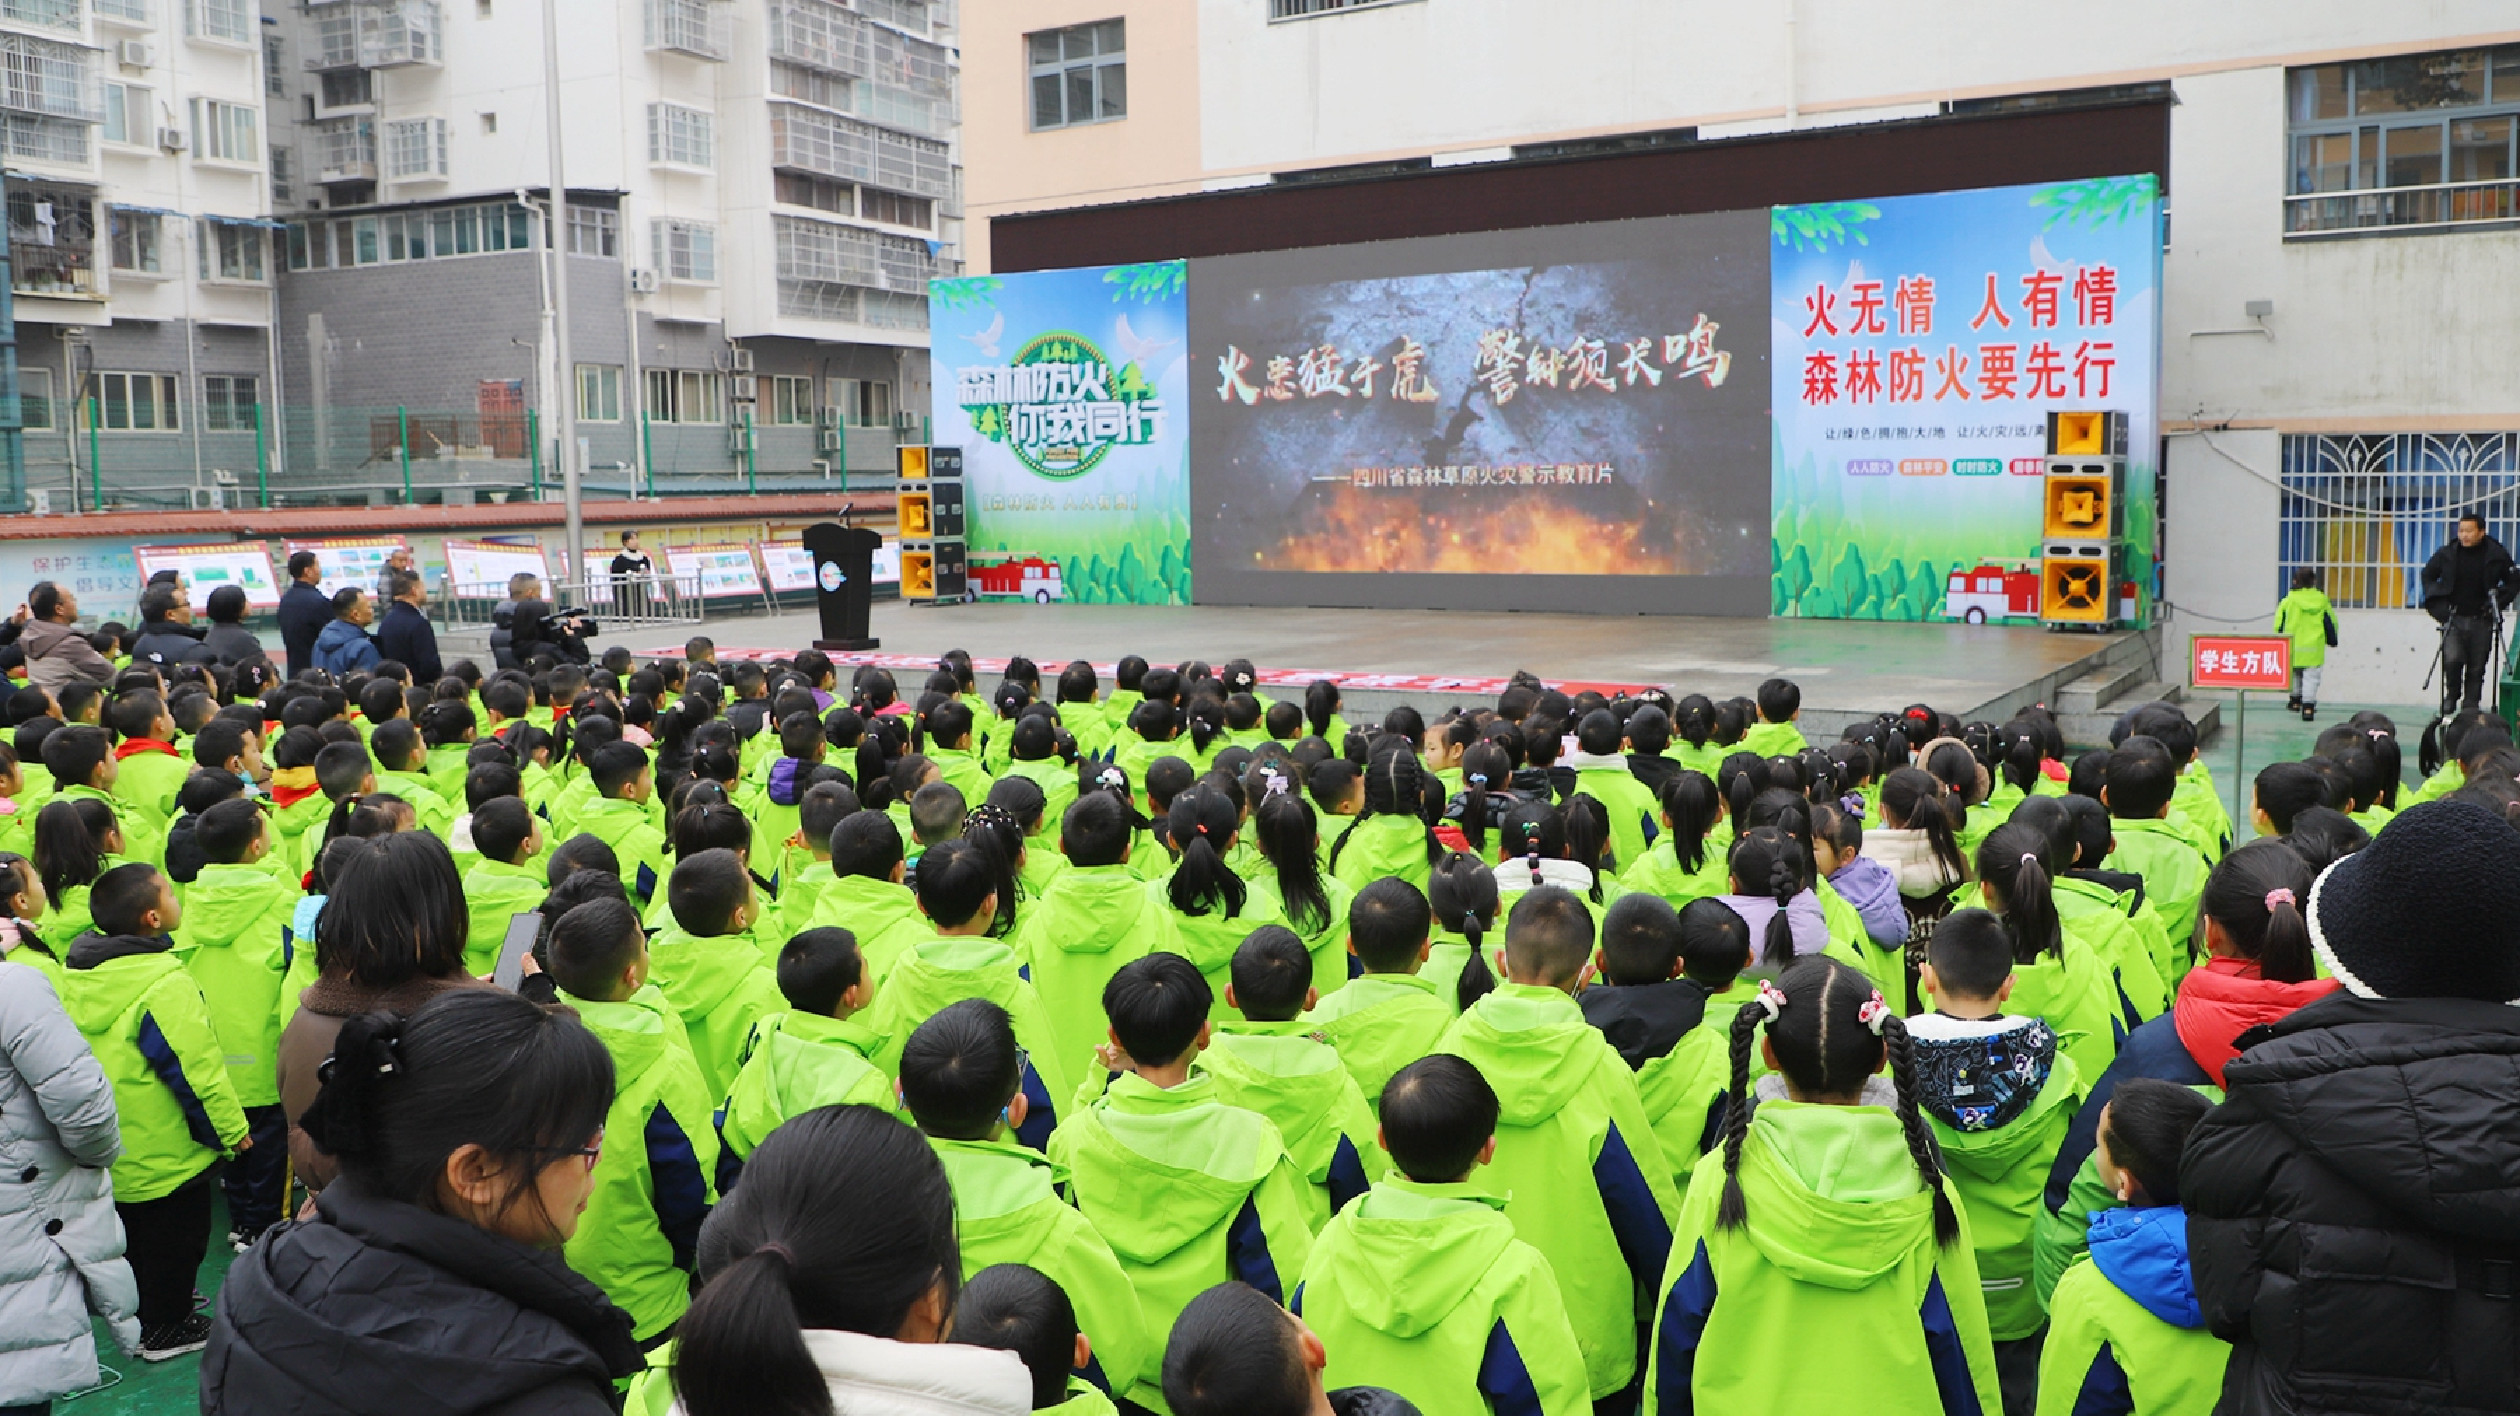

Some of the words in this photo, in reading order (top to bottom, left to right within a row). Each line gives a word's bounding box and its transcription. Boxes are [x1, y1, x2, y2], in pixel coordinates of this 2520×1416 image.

[1804, 275, 1935, 337] 火无情
[1969, 266, 2116, 330] 人有情
[957, 361, 1110, 402] 森林防火
[1802, 341, 2115, 404] 森林防火要先行
[1009, 401, 1167, 445] 你我同行
[2199, 649, 2282, 675] 学生方队
